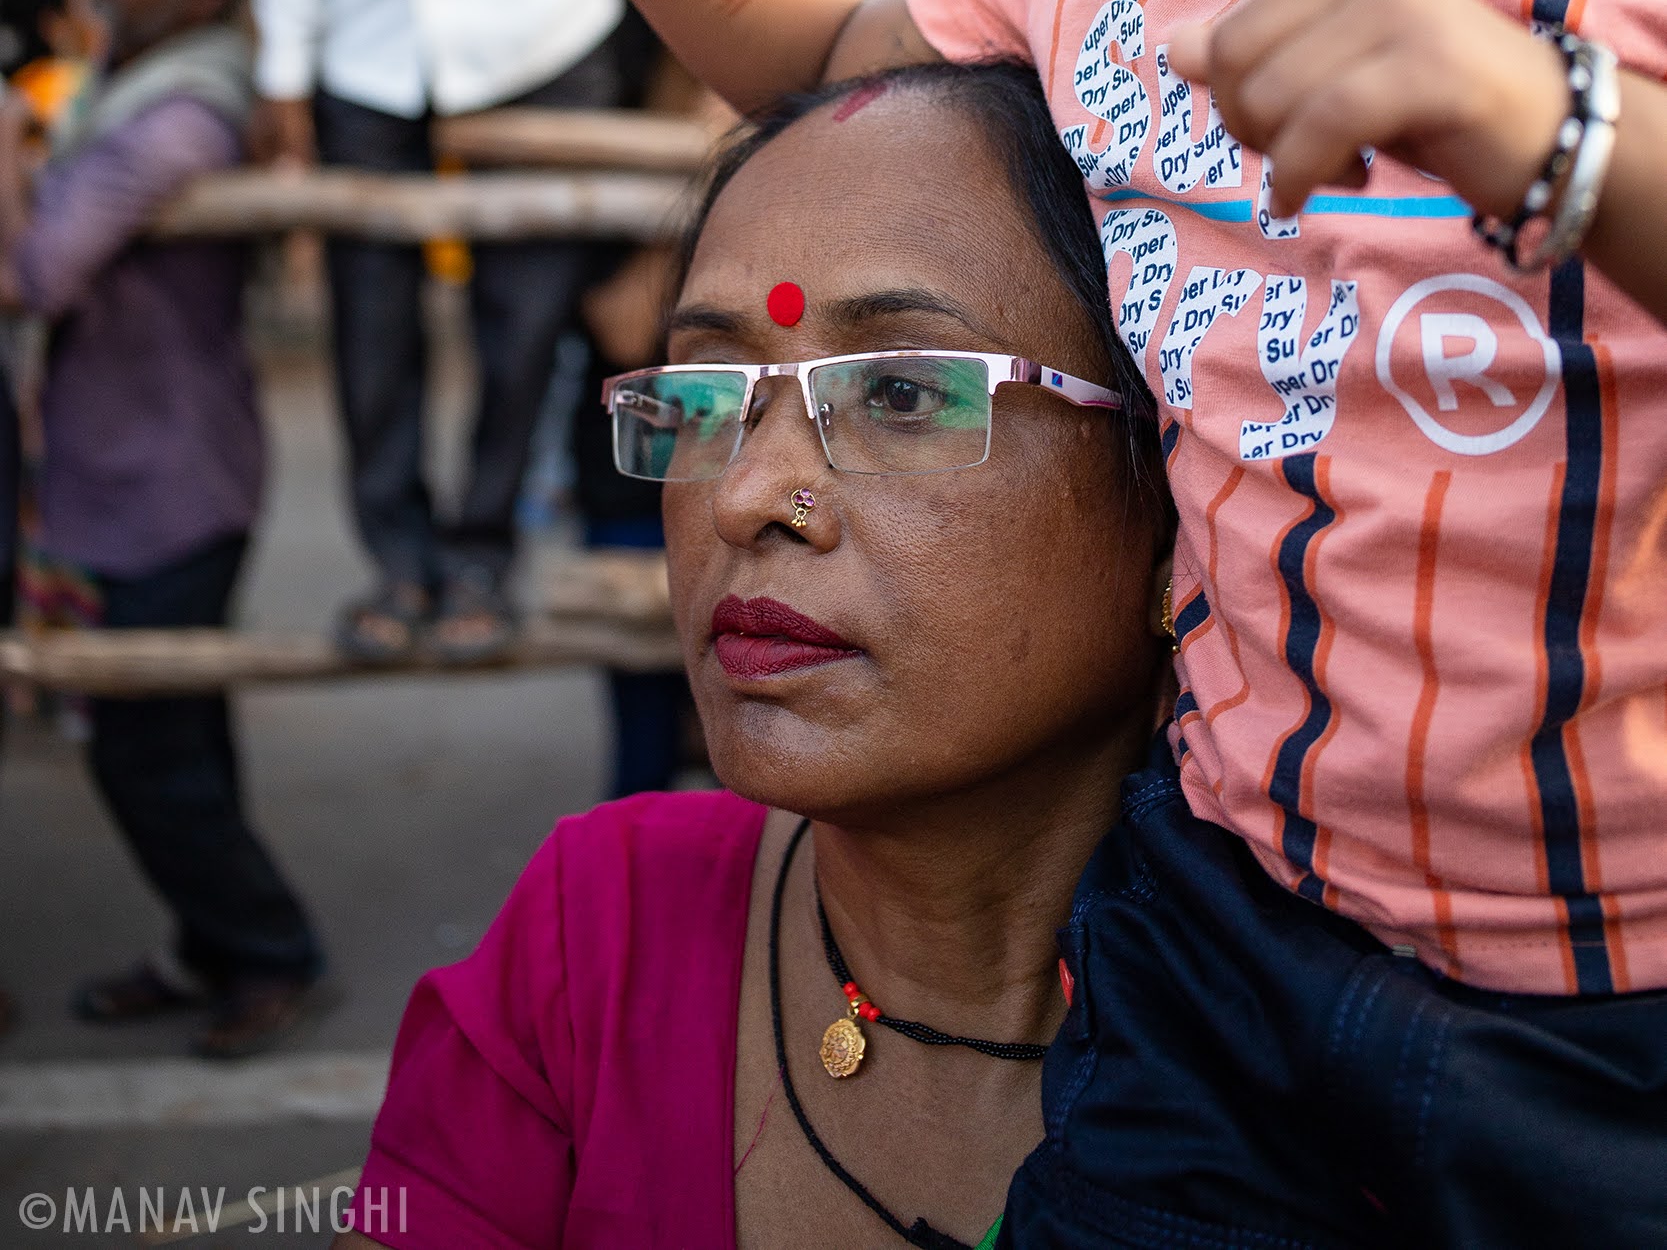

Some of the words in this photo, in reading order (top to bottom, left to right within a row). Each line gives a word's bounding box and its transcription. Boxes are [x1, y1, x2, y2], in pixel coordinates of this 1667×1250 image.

[1081, 13, 1109, 54] uper
[1118, 114, 1149, 146] Dry
[1161, 147, 1191, 182] Dry
[1111, 217, 1141, 245] Dry
[1142, 262, 1174, 286] Dry
[1184, 305, 1217, 333] Dry
[1302, 394, 1335, 416] Dr
